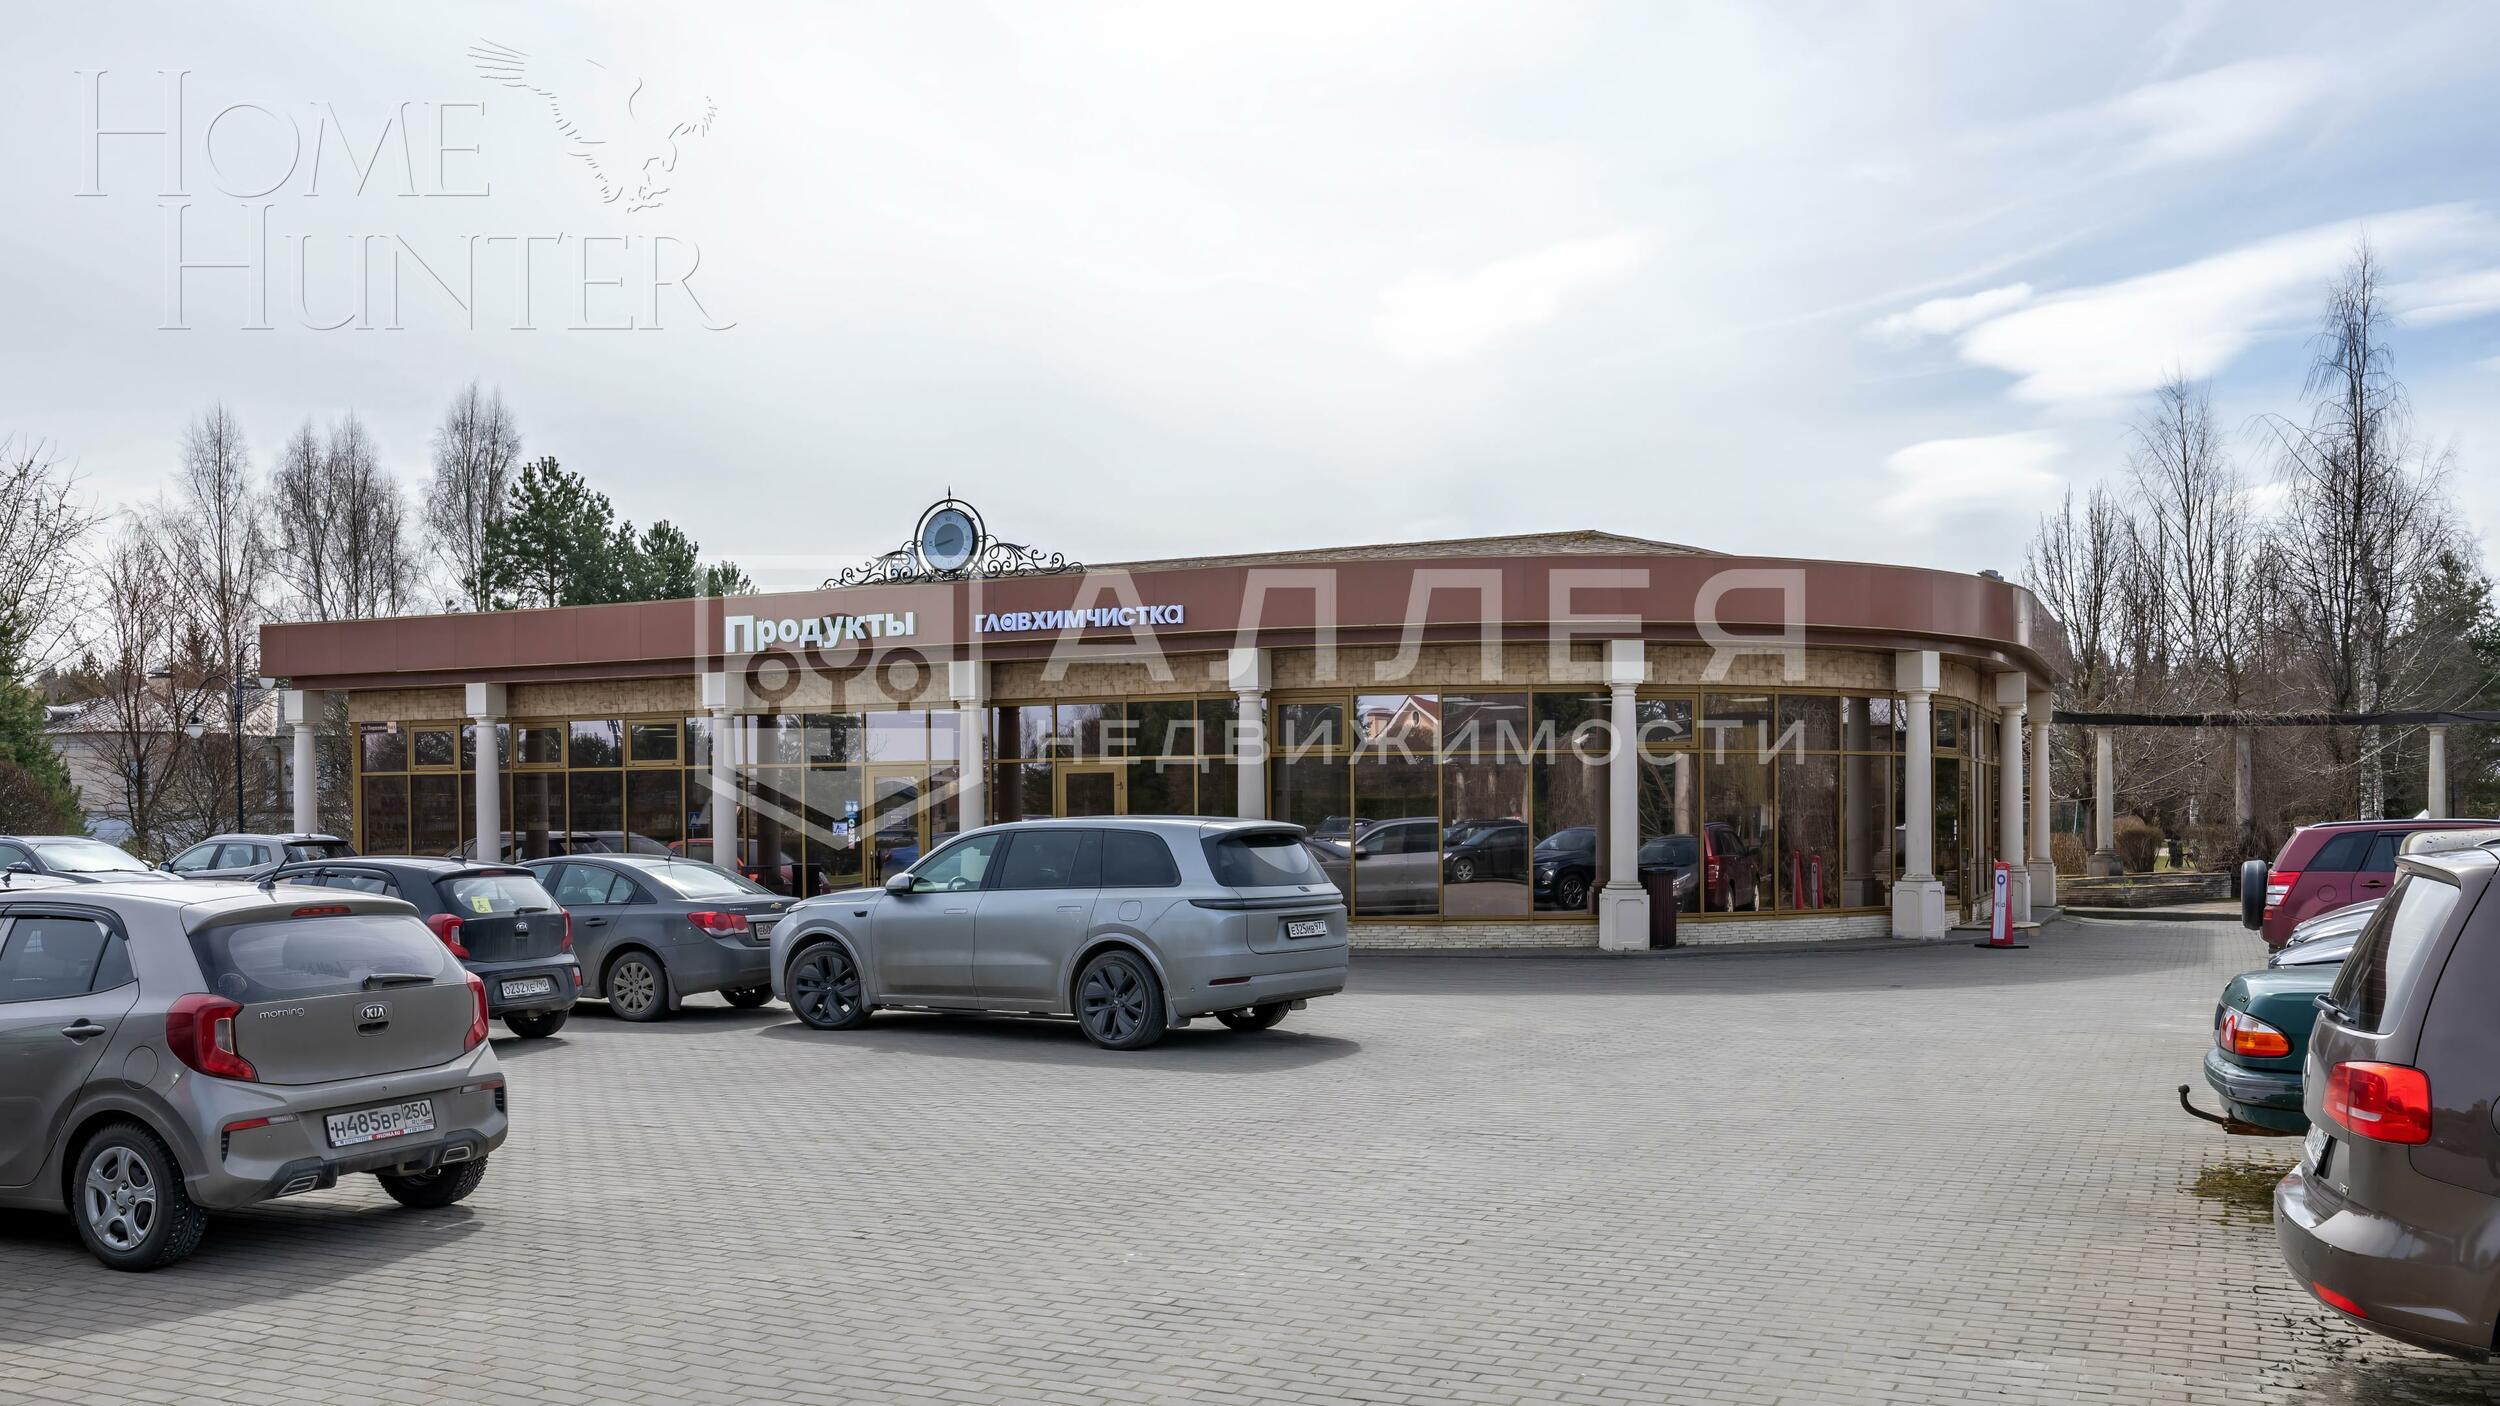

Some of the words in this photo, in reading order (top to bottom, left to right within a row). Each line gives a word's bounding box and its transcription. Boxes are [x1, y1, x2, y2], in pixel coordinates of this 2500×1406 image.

[725, 611, 915, 653] Продукты
[259, 1007, 305, 1019] morning
[365, 1006, 385, 1018] KIA
